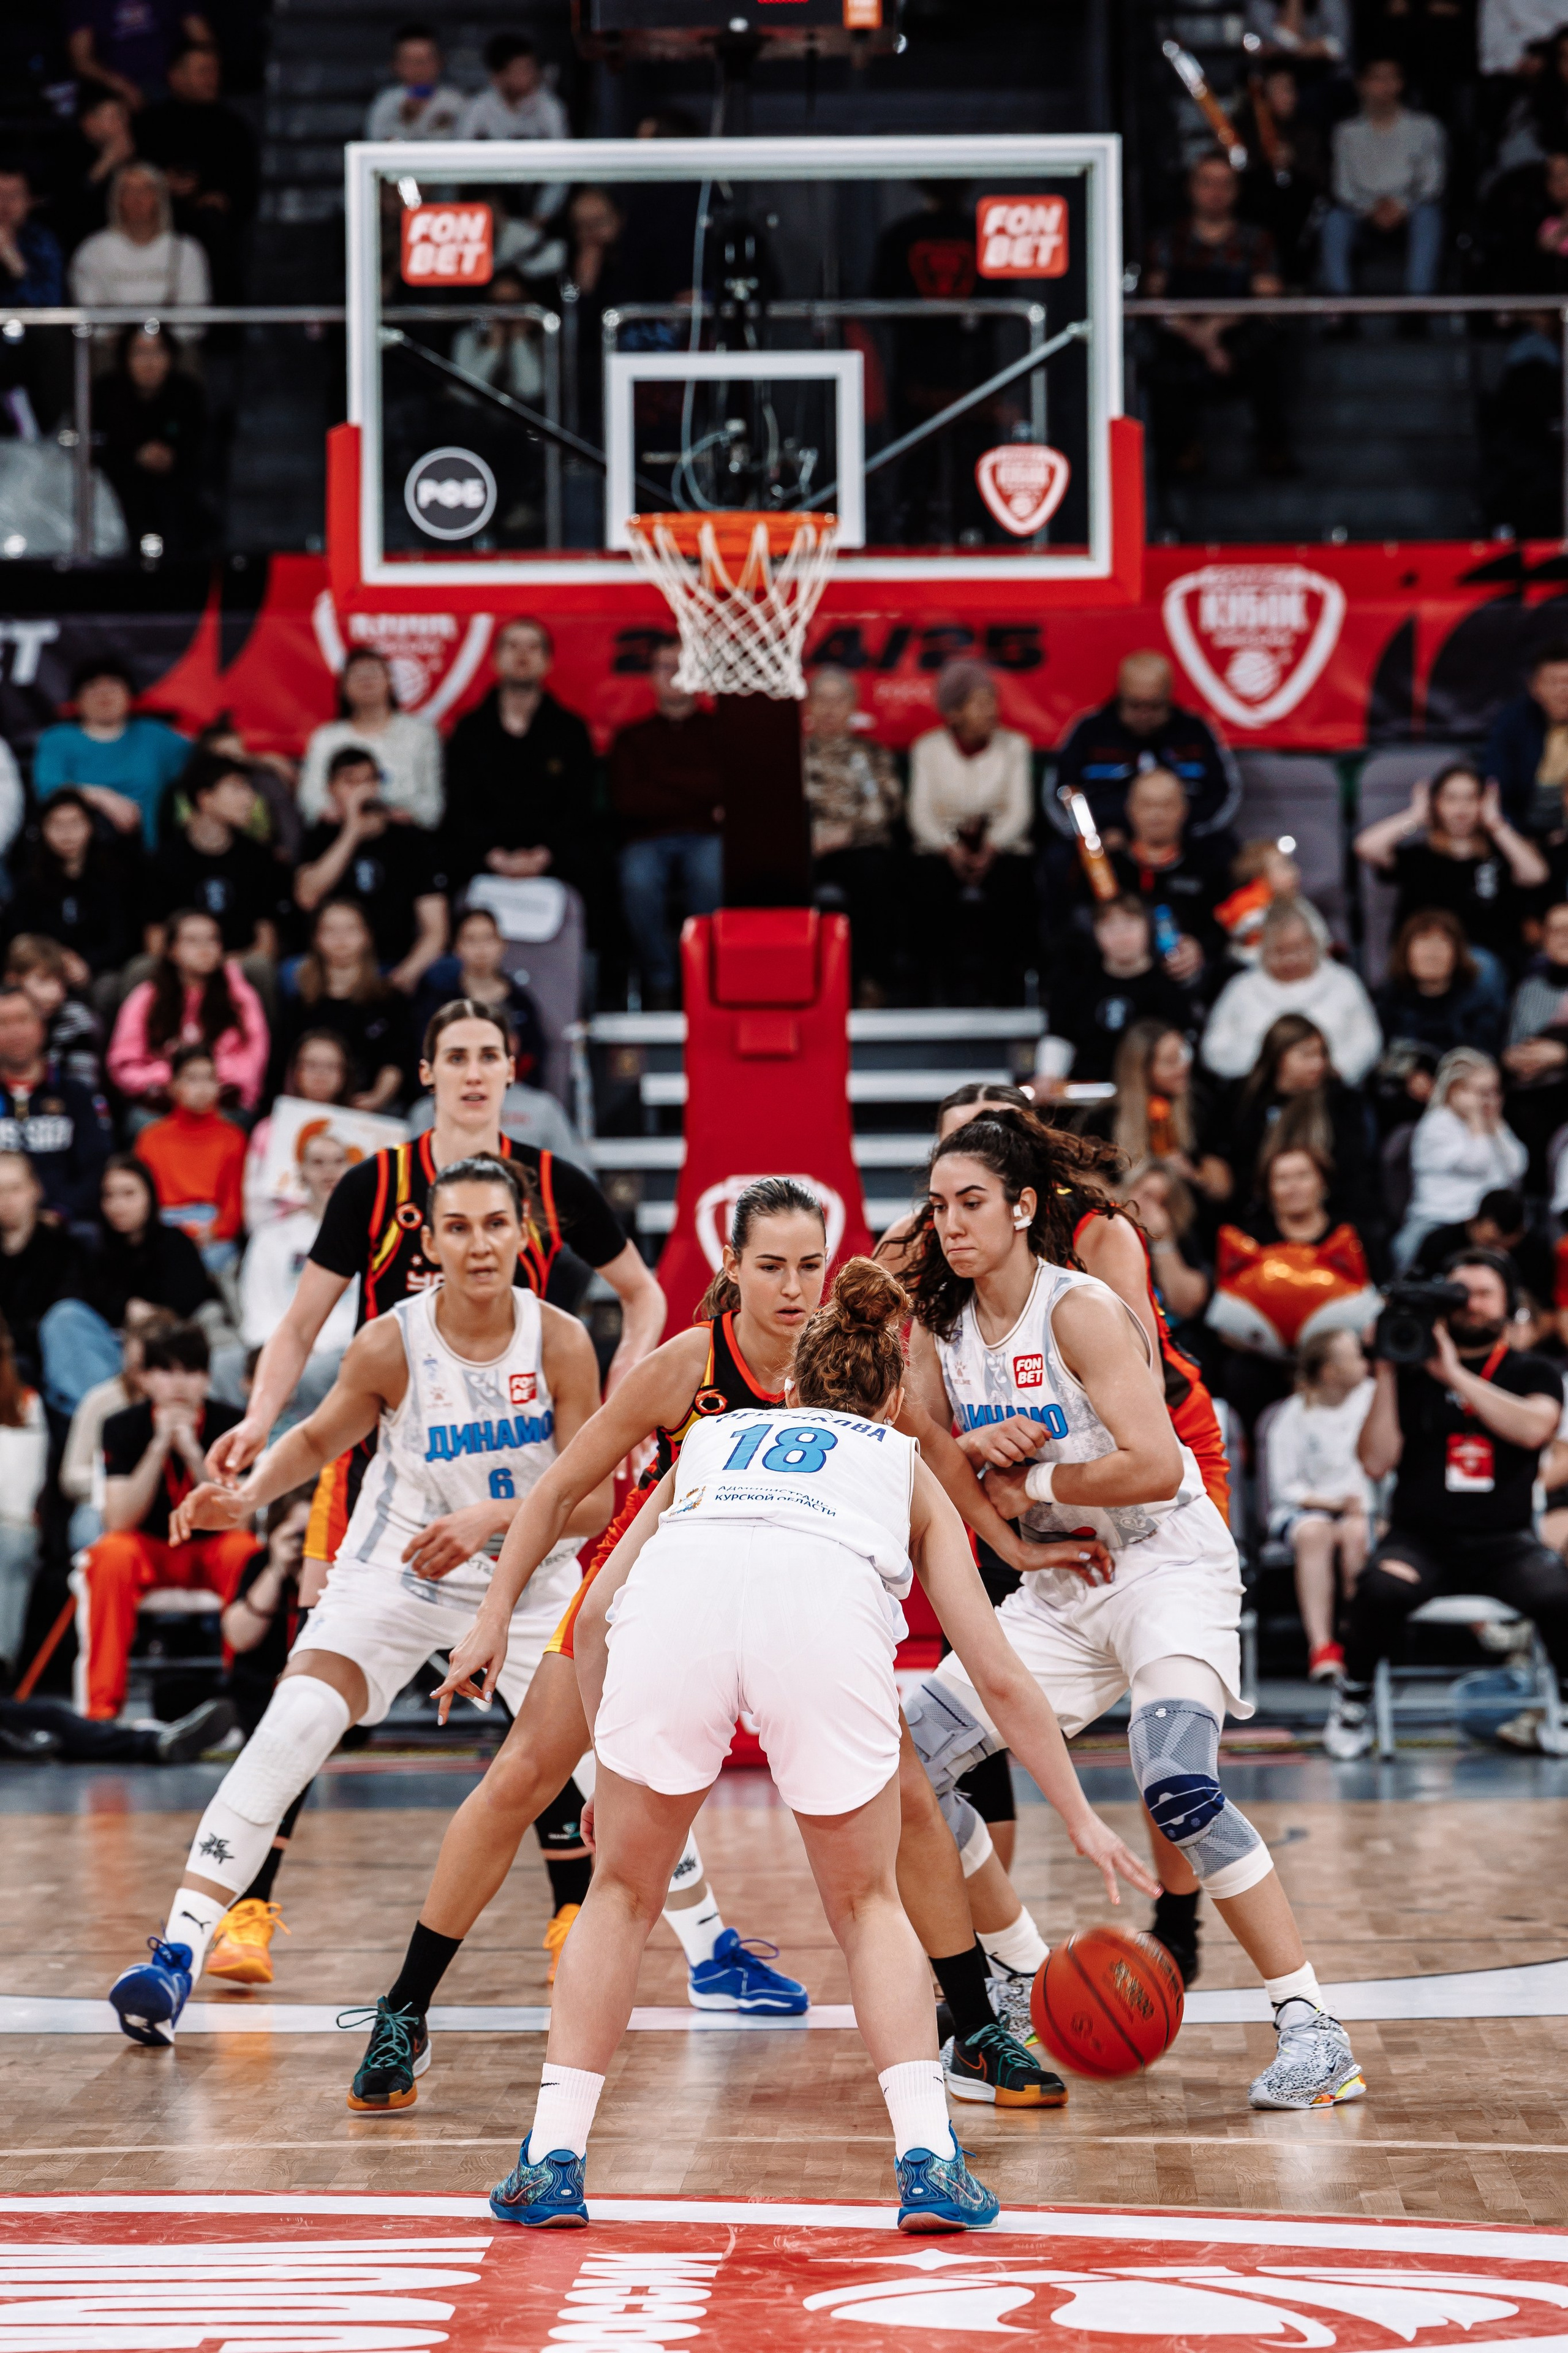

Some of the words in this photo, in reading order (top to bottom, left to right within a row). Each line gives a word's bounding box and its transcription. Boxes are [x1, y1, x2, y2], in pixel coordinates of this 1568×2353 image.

[407, 211, 487, 244] FON
[983, 203, 1063, 236] FON
[407, 242, 488, 275] BET
[982, 233, 1063, 268] BET
[1016, 1356, 1042, 1372] FON
[1017, 1369, 1042, 1384] BET
[425, 1410, 554, 1463] ДИНАМО
[722, 1423, 839, 1473] 18
[488, 1468, 515, 1500] 6
